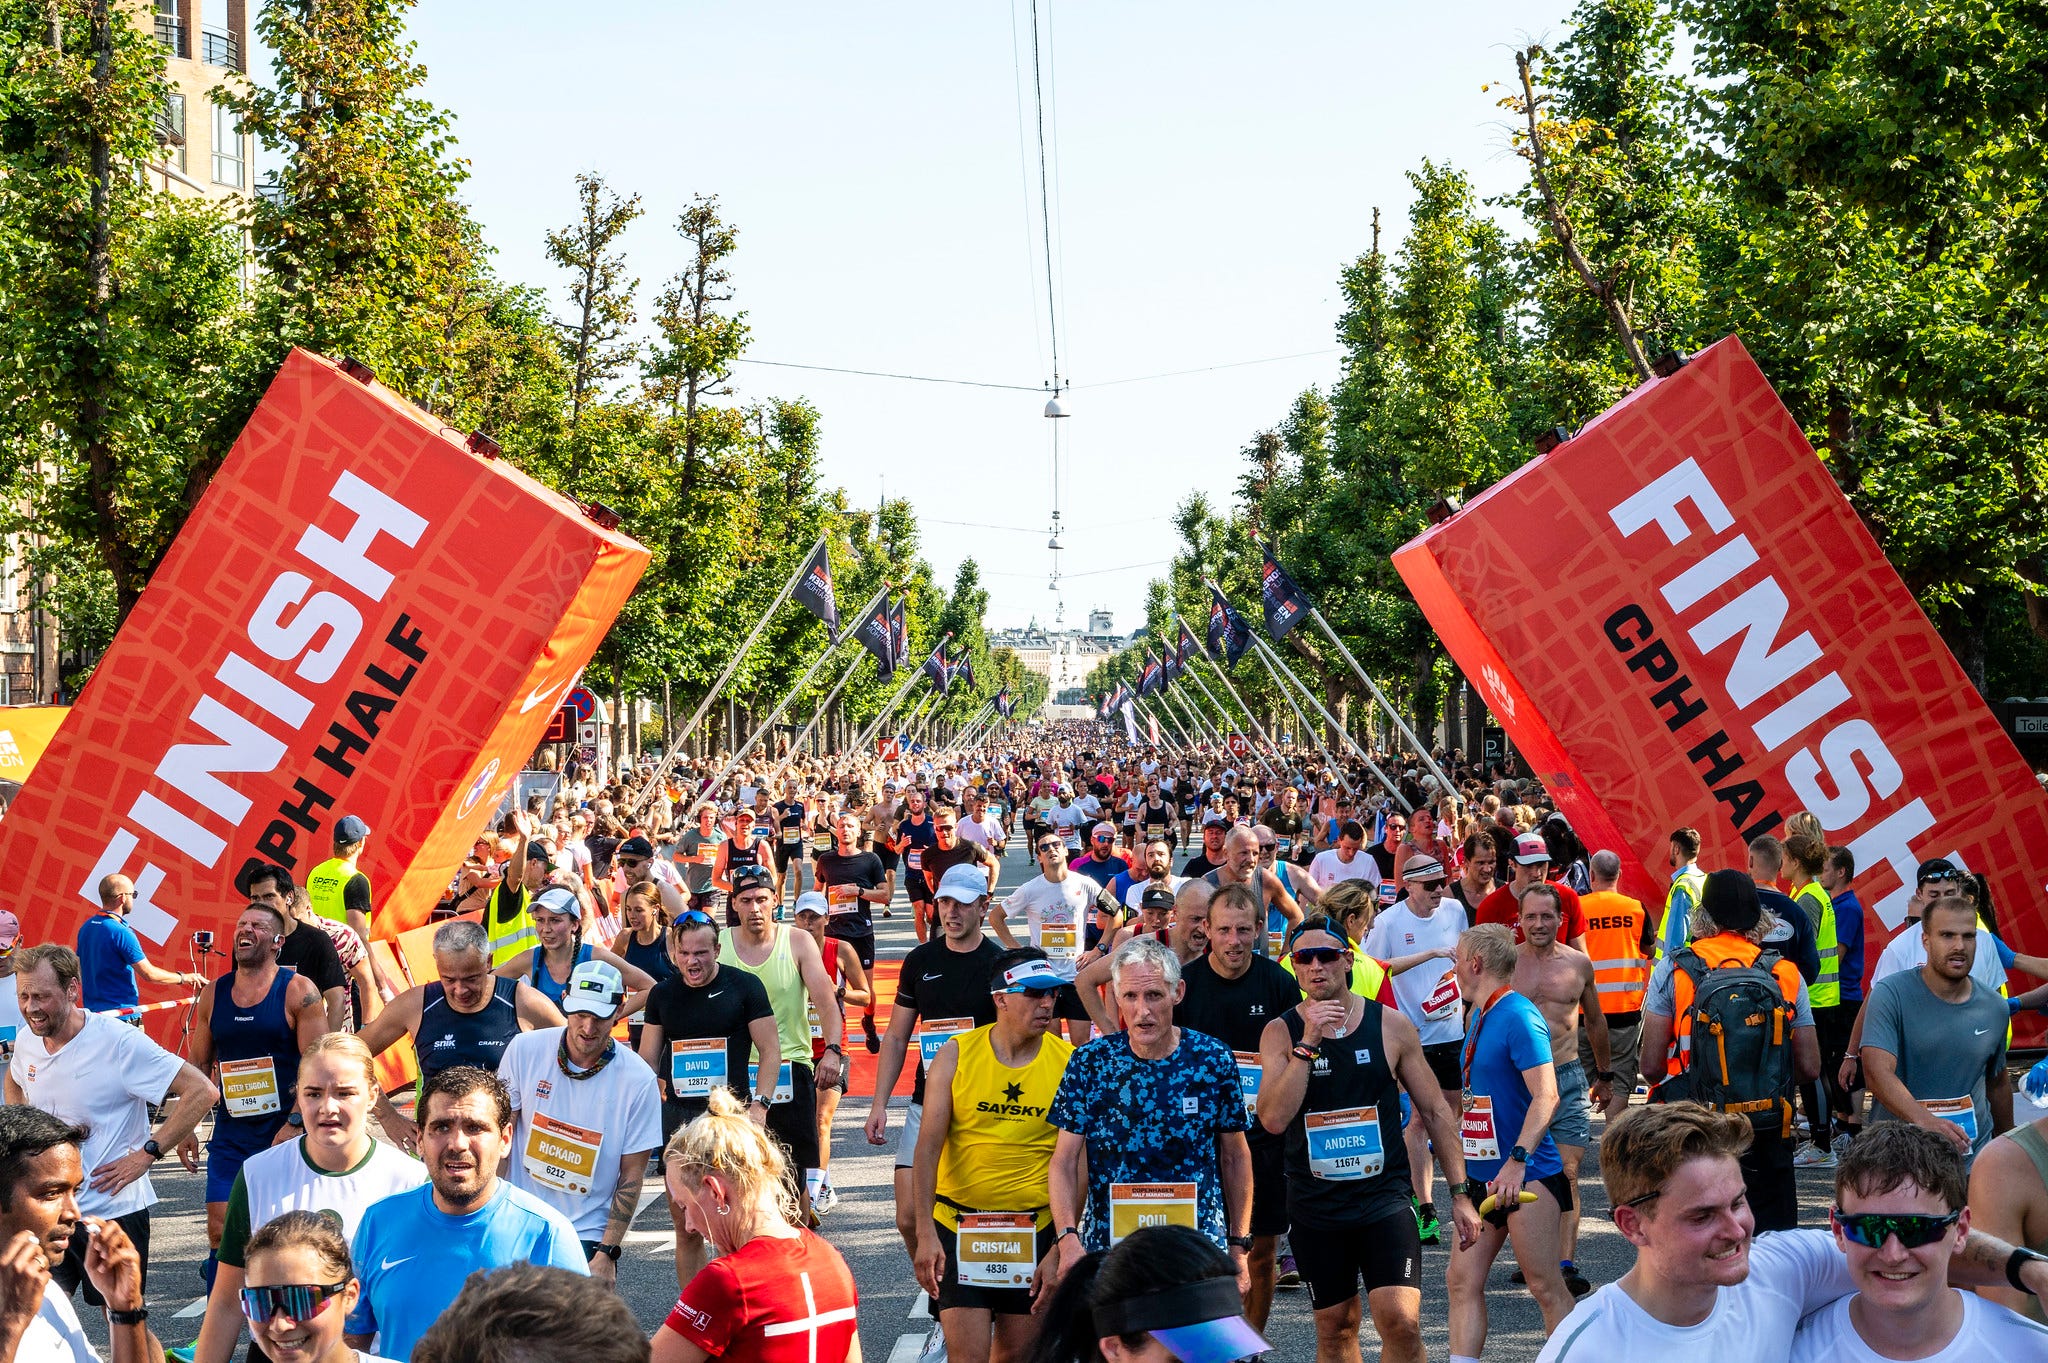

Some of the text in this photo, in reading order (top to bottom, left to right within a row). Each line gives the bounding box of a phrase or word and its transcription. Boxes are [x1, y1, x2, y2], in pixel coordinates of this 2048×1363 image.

[1603, 603, 1708, 732] CPH
[313, 613, 429, 778] HALF
[1608, 456, 1970, 932] FINISH
[78, 469, 429, 946] FINISH
[1233, 739, 1246, 751] 21
[1485, 740, 1497, 758] P
[1586, 915, 1633, 930] RESS
[1052, 936, 1065, 944] JACK
[685, 1060, 710, 1072] DAVID
[688, 1077, 708, 1086] 12872
[241, 1097, 257, 1106] 7494
[976, 1101, 1046, 1117] SAYSKY
[1325, 1135, 1366, 1151] ANDERS
[538, 1140, 582, 1165] RICKARD
[1335, 1157, 1361, 1168] 11674
[546, 1165, 566, 1179] 6212
[971, 1241, 1021, 1254] CRISTIAN
[985, 1264, 1008, 1273] 4836
